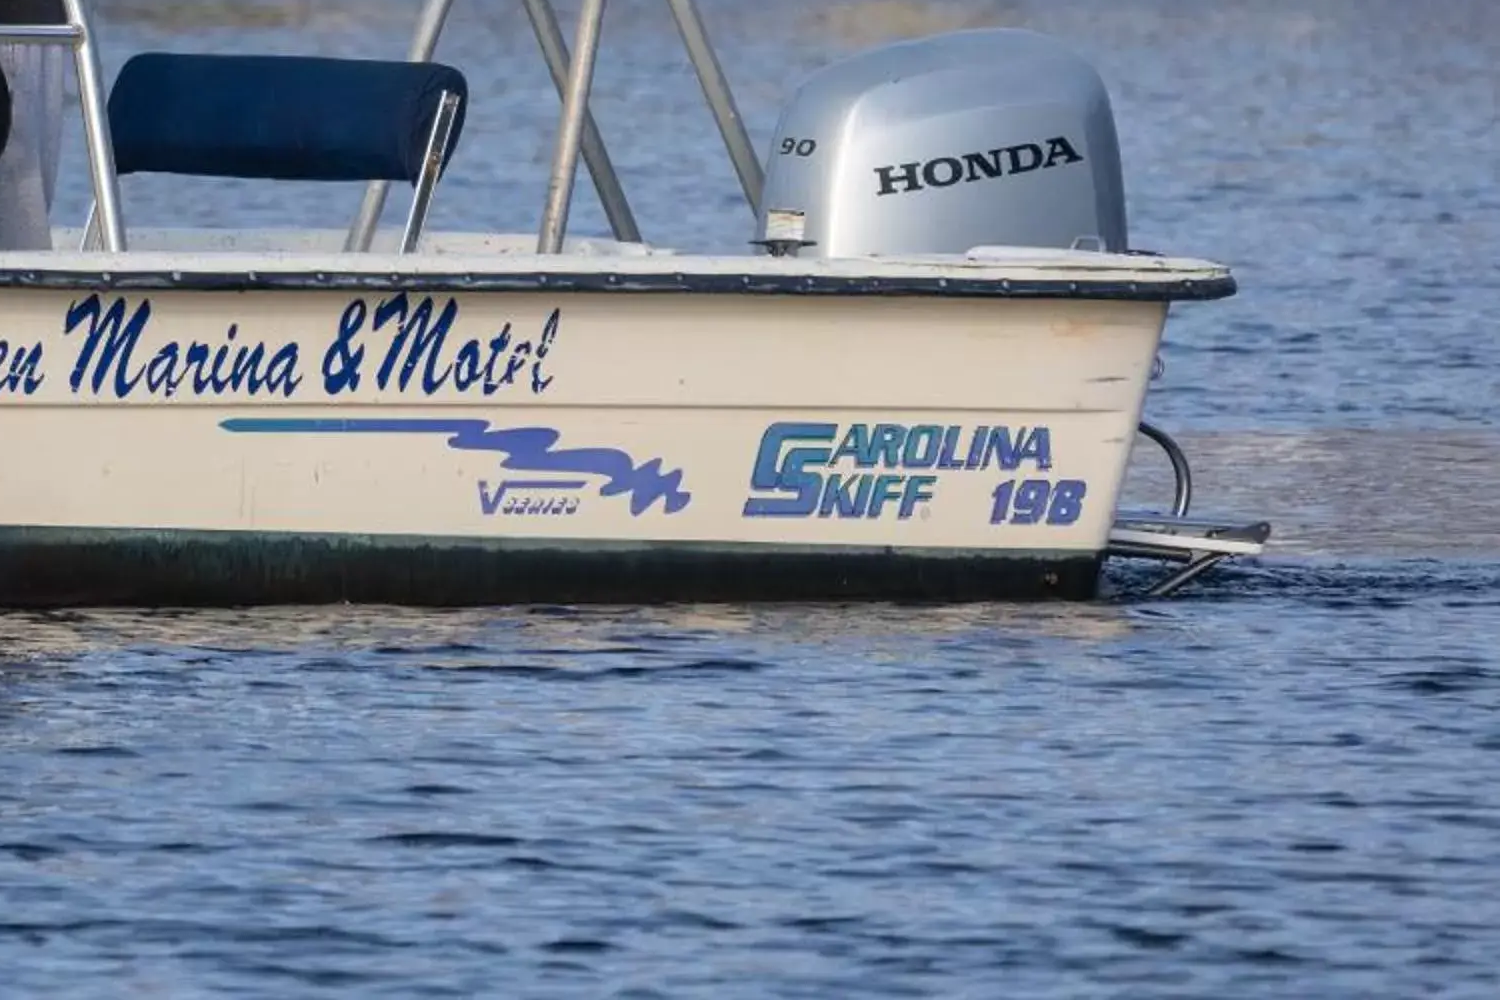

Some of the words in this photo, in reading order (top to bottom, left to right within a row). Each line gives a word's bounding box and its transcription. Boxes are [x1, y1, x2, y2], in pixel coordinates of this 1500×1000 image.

[779, 137, 817, 157] 90
[874, 136, 1083, 196] HONDA
[64, 294, 304, 398] Marina
[742, 447, 937, 519] SKIFF
[751, 422, 1052, 489] CAROLINA
[990, 479, 1087, 525] 198
